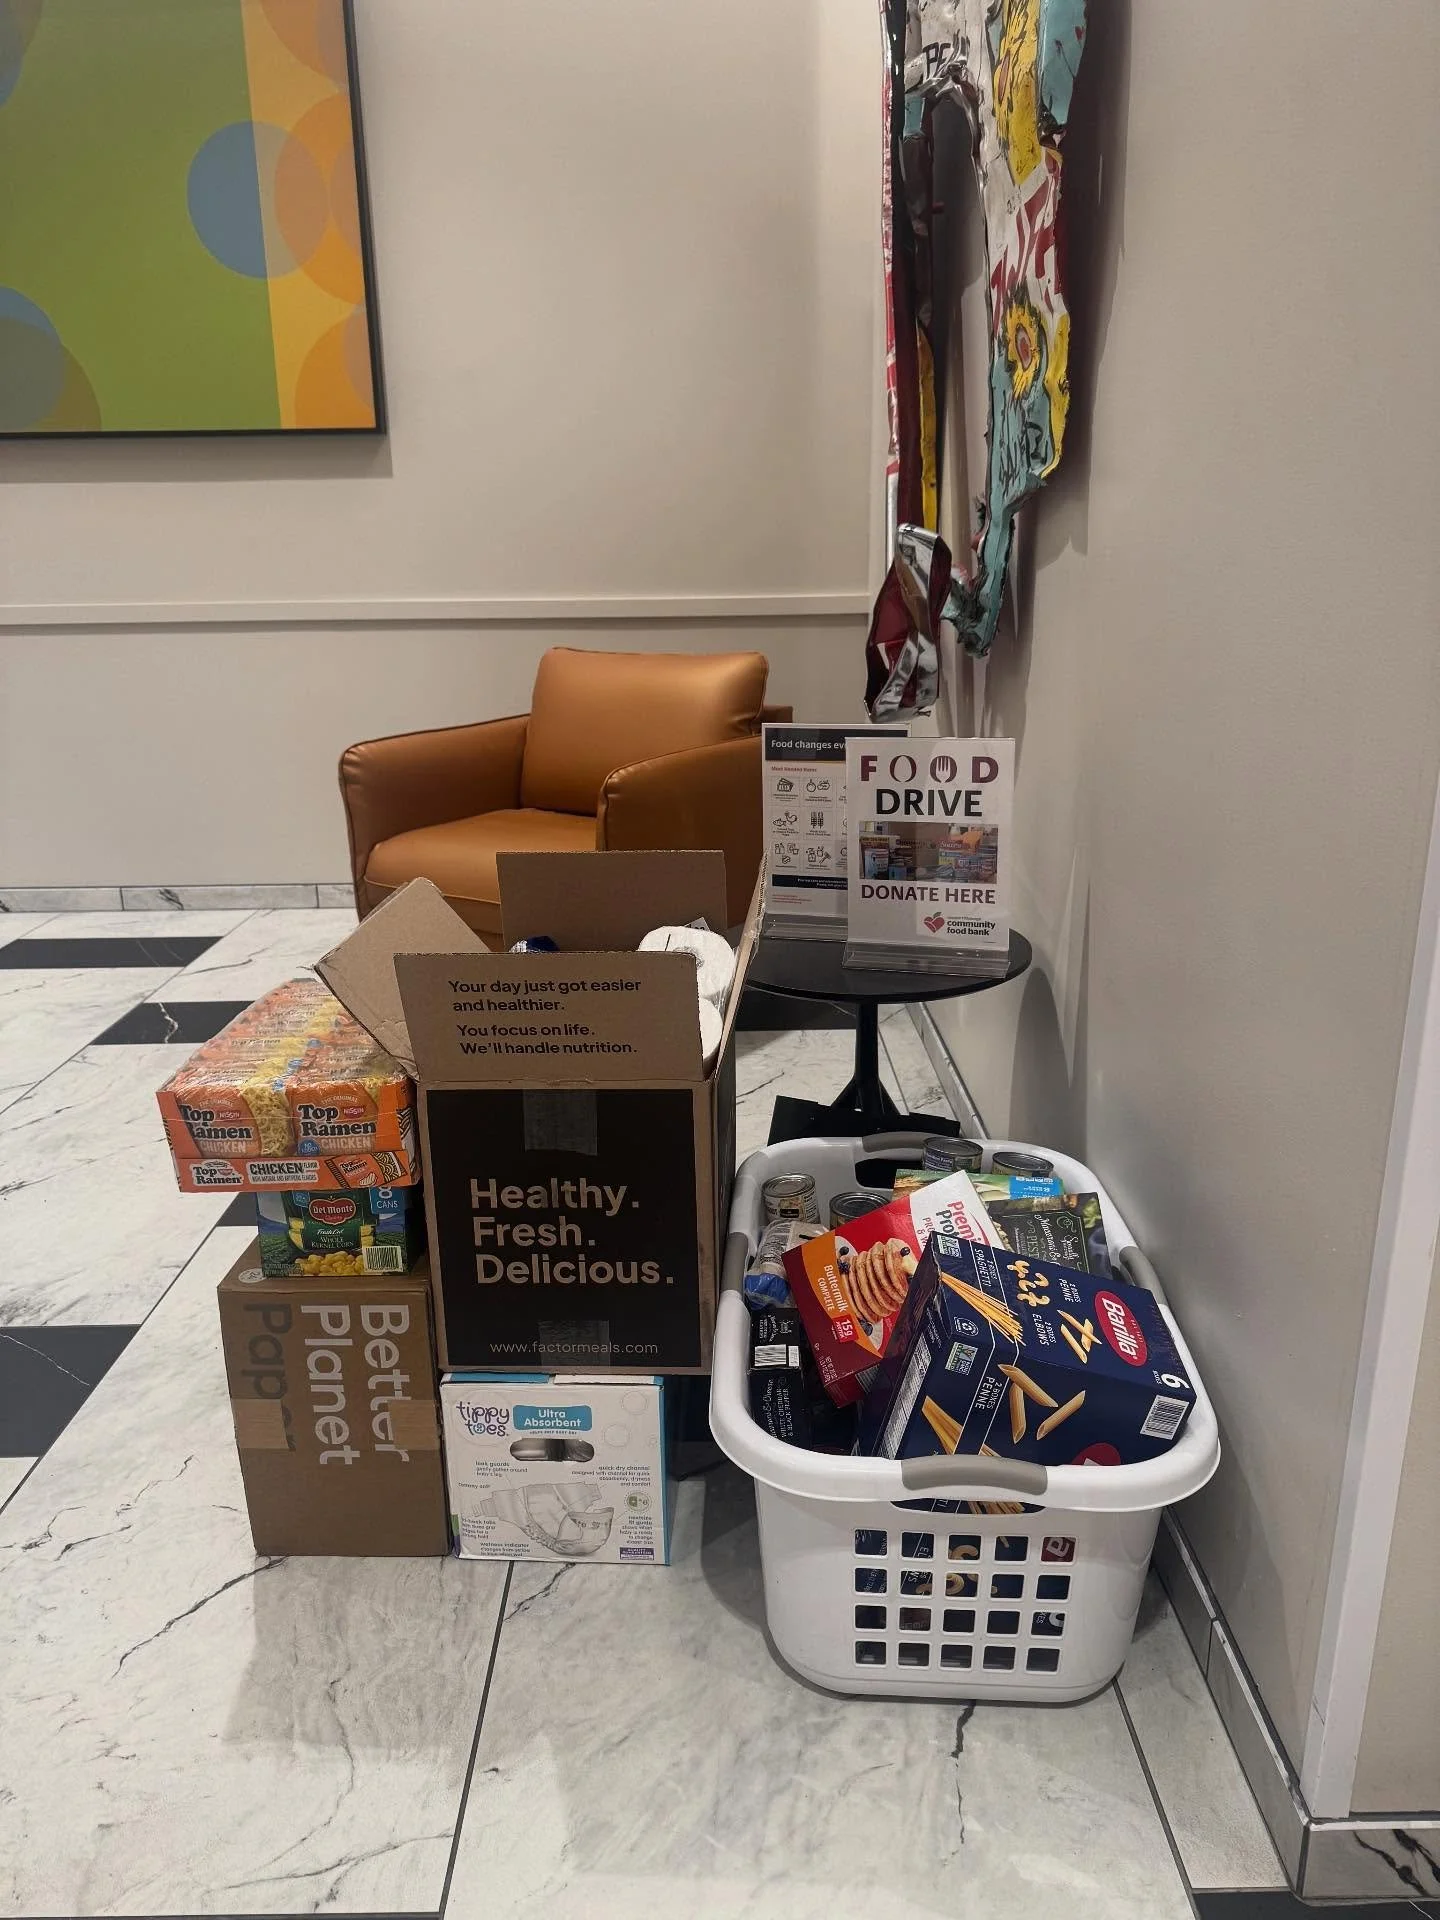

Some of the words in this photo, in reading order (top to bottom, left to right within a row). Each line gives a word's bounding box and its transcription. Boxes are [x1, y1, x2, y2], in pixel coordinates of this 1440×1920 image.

[771, 740, 793, 748] Food
[795, 740, 831, 751] changes
[860, 754, 999, 784] FOOD
[876, 788, 983, 817] DRIVE
[861, 884, 939, 902] DONATE
[945, 888, 996, 905] HERE
[947, 920, 996, 929] community
[947, 927, 967, 935] food
[968, 928, 990, 936] bank
[448, 980, 486, 993] Your
[489, 980, 521, 995] day
[524, 980, 555, 995] just
[558, 980, 588, 994] got
[590, 979, 642, 992] easier
[452, 999, 484, 1012] and
[487, 999, 565, 1012] healthier.
[457, 1024, 489, 1037] You
[491, 1024, 538, 1037] focus
[541, 1027, 562, 1036] on
[564, 1023, 596, 1036] life.
[459, 1042, 501, 1055] We'll
[505, 1042, 559, 1054] handle
[563, 1041, 637, 1054] nutrition.
[298, 1104, 339, 1122] Top
[300, 1120, 377, 1136] Ramen
[200, 1140, 247, 1153] CHICKEN
[320, 1136, 372, 1150] CHICKEN
[192, 1166, 218, 1176] Top
[249, 1162, 304, 1175] CHICKEN
[195, 1175, 242, 1184] Ramen
[376, 1200, 398, 1209] CANS
[470, 1177, 640, 1217] Healthy.
[313, 1205, 326, 1214] Del
[327, 1205, 353, 1214] Monte
[472, 1215, 596, 1247] Fresh.
[1027, 1235, 1040, 1262] PEST
[475, 1253, 675, 1284] Delicious.
[975, 1248, 992, 1287] SPAGHETTI
[817, 1277, 835, 1311] COMPLETE
[824, 1264, 849, 1312] Buttermilk
[1059, 1278, 1074, 1302] PENNE
[841, 1319, 853, 1336] 15g
[1032, 1313, 1050, 1346] ELBOWS
[1101, 1297, 1139, 1356] Barilla
[490, 1341, 659, 1354] www.factormeals.com
[242, 1303, 296, 1450] Pap
[301, 1304, 361, 1465] Planet
[360, 1304, 411, 1463] Better
[1161, 1373, 1190, 1389] 6
[975, 1376, 996, 1410] PENNE
[986, 1388, 1001, 1409] BOXES
[456, 1401, 510, 1425] tippy
[538, 1409, 566, 1418] Ultra
[465, 1419, 506, 1437] toes
[523, 1418, 581, 1428] Absorbent
